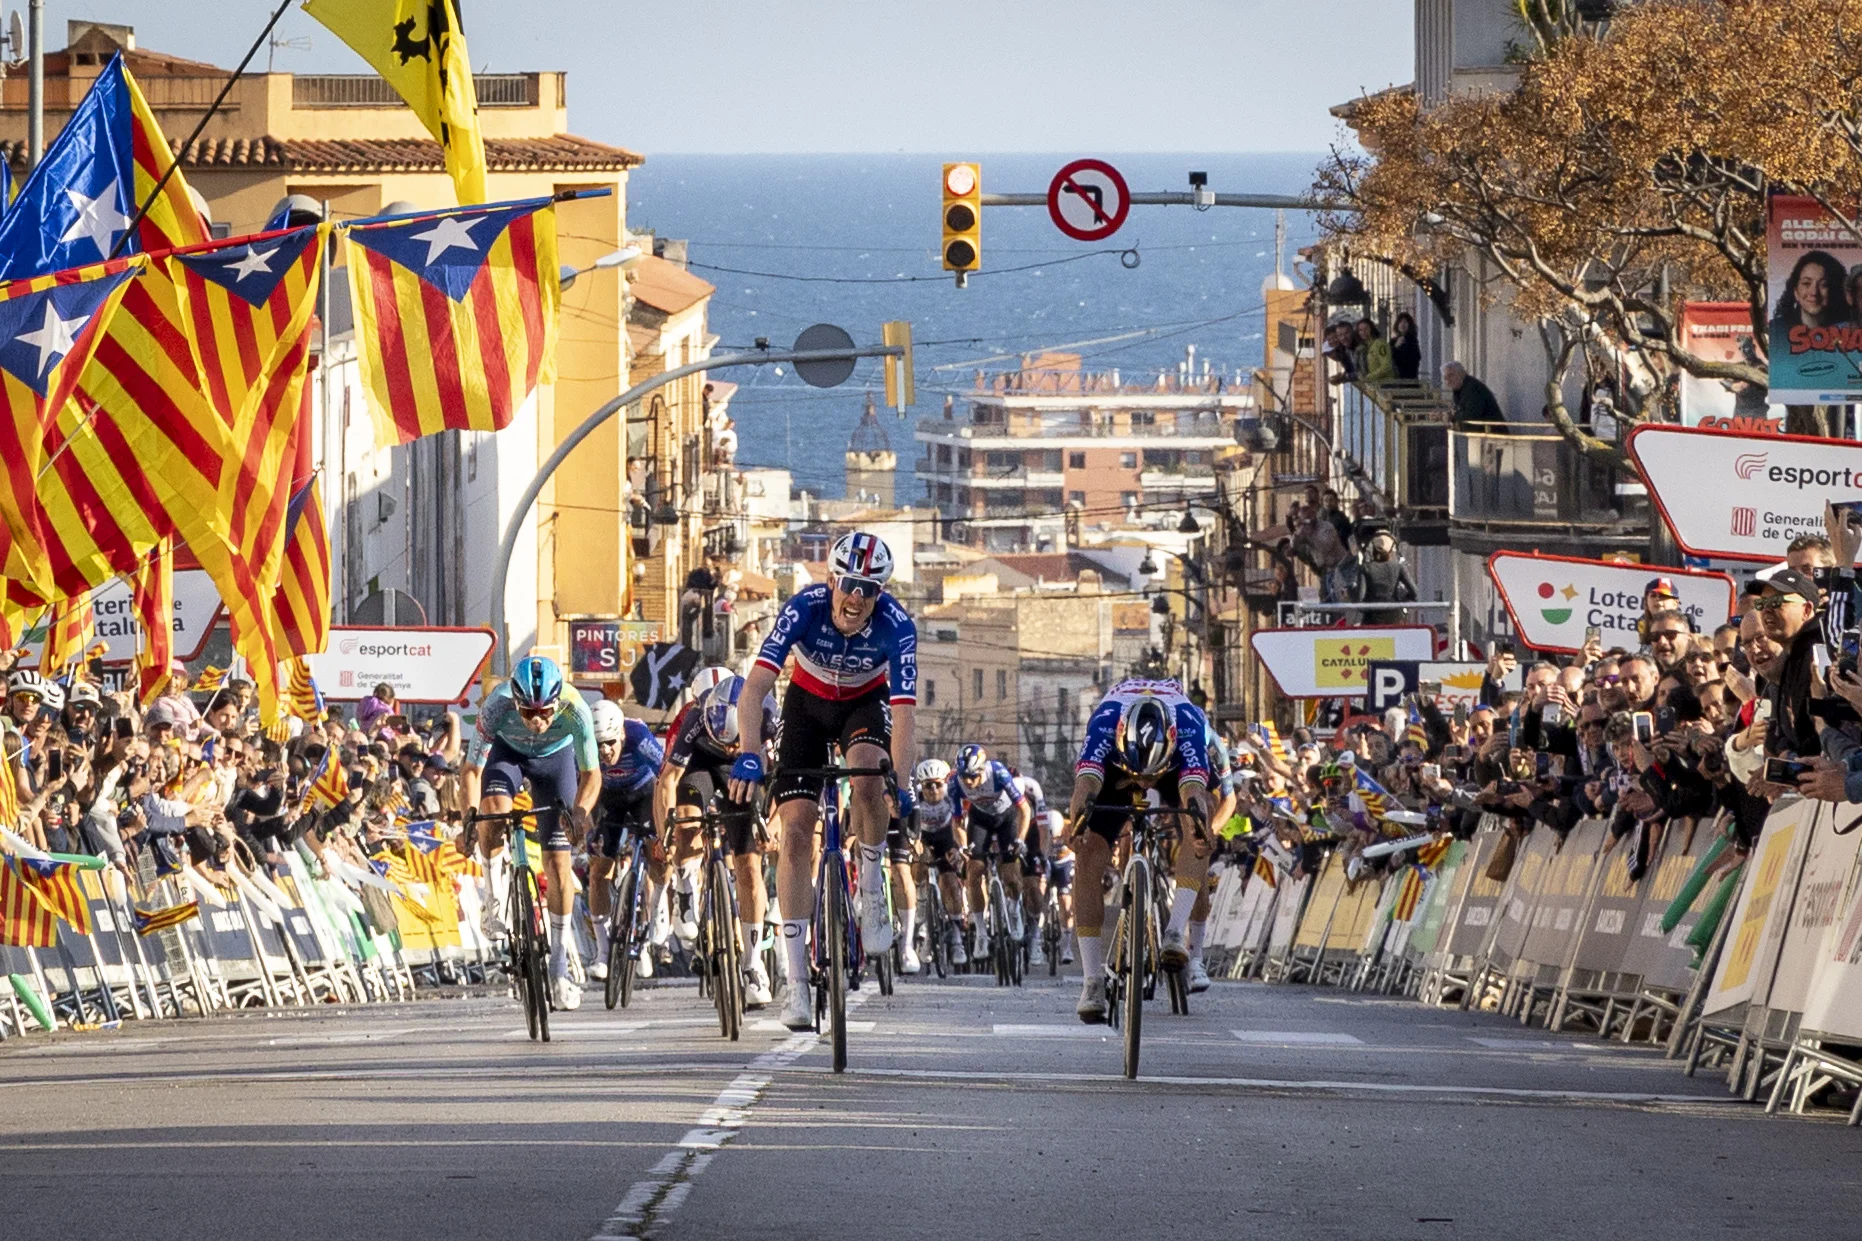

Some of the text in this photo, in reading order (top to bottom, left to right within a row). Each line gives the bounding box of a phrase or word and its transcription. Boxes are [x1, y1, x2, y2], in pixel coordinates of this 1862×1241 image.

[1763, 511, 1825, 528] Generali
[1763, 527, 1779, 540] de
[576, 629, 659, 642] PINTORES
[762, 605, 800, 658] INEOS
[359, 643, 432, 658] esportcat
[810, 650, 874, 670] INEOS
[898, 634, 918, 691] INEOS
[1322, 656, 1386, 668] CATALU
[357, 671, 403, 680] Generalitat
[1374, 668, 1405, 708] P
[1178, 740, 1201, 768] BOSS
